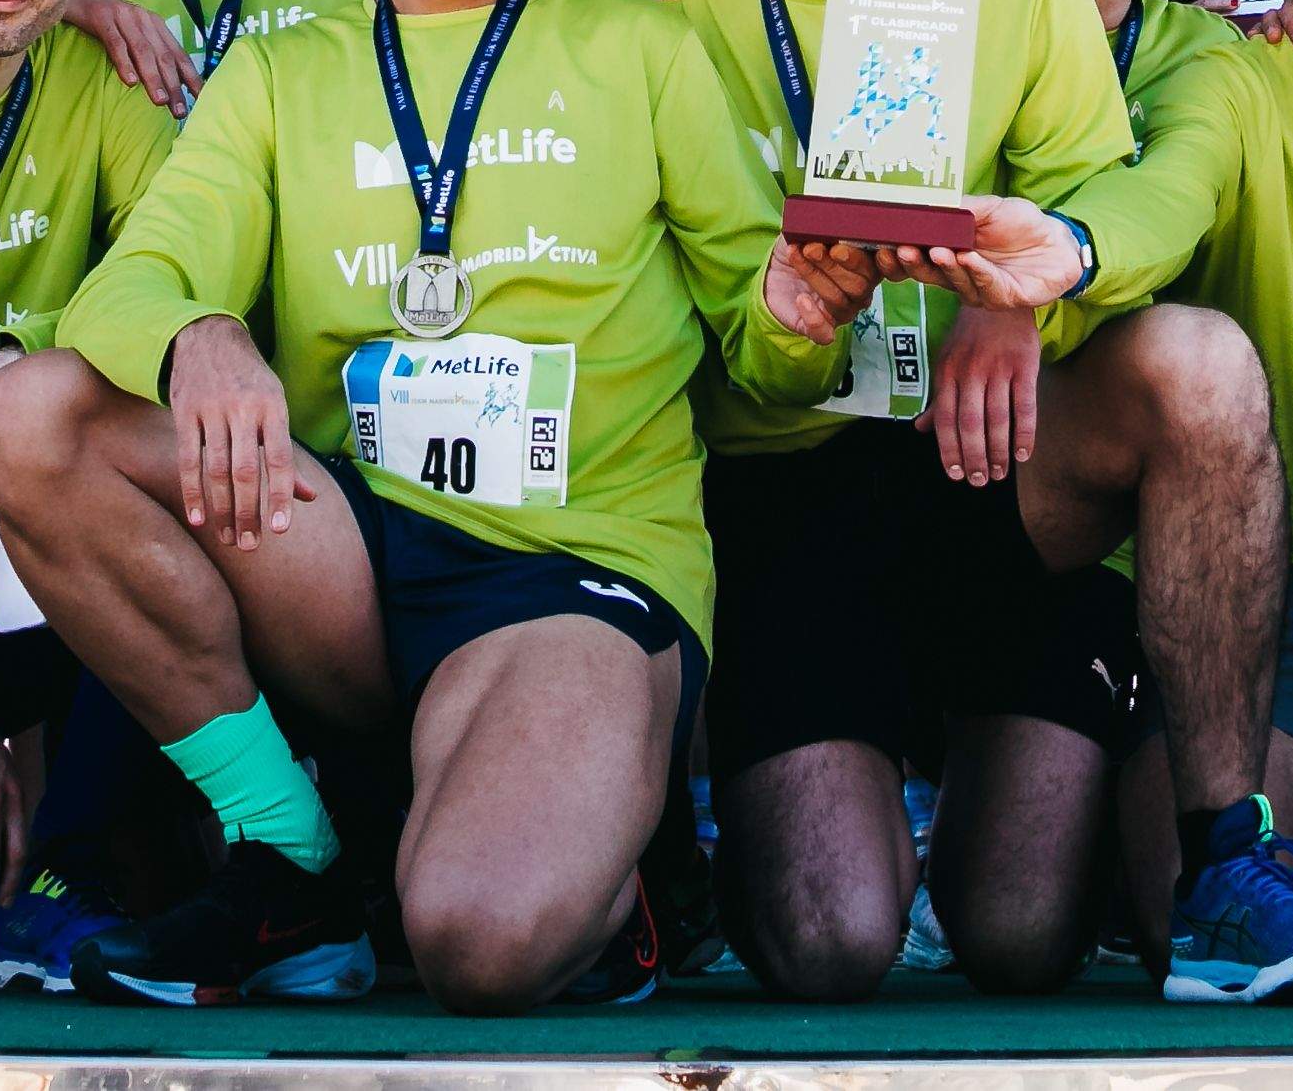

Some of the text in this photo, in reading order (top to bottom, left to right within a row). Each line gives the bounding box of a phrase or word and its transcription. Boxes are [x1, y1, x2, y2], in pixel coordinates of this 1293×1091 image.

[215, 12, 233, 50] MetLife
[485, 44, 496, 56] 15K
[491, 13, 509, 41] METLIFE
[776, 20, 785, 35] 15K
[870, 16, 959, 32] CLASIFICADO
[887, 29, 940, 43] PRENSA
[434, 168, 456, 215] MetLife
[334, 225, 599, 287] VIII MADRID ACTIVA
[408, 311, 451, 323] MetLife
[430, 355, 520, 377] MetLife
[390, 389, 409, 405] VIII
[419, 437, 477, 495] 40
